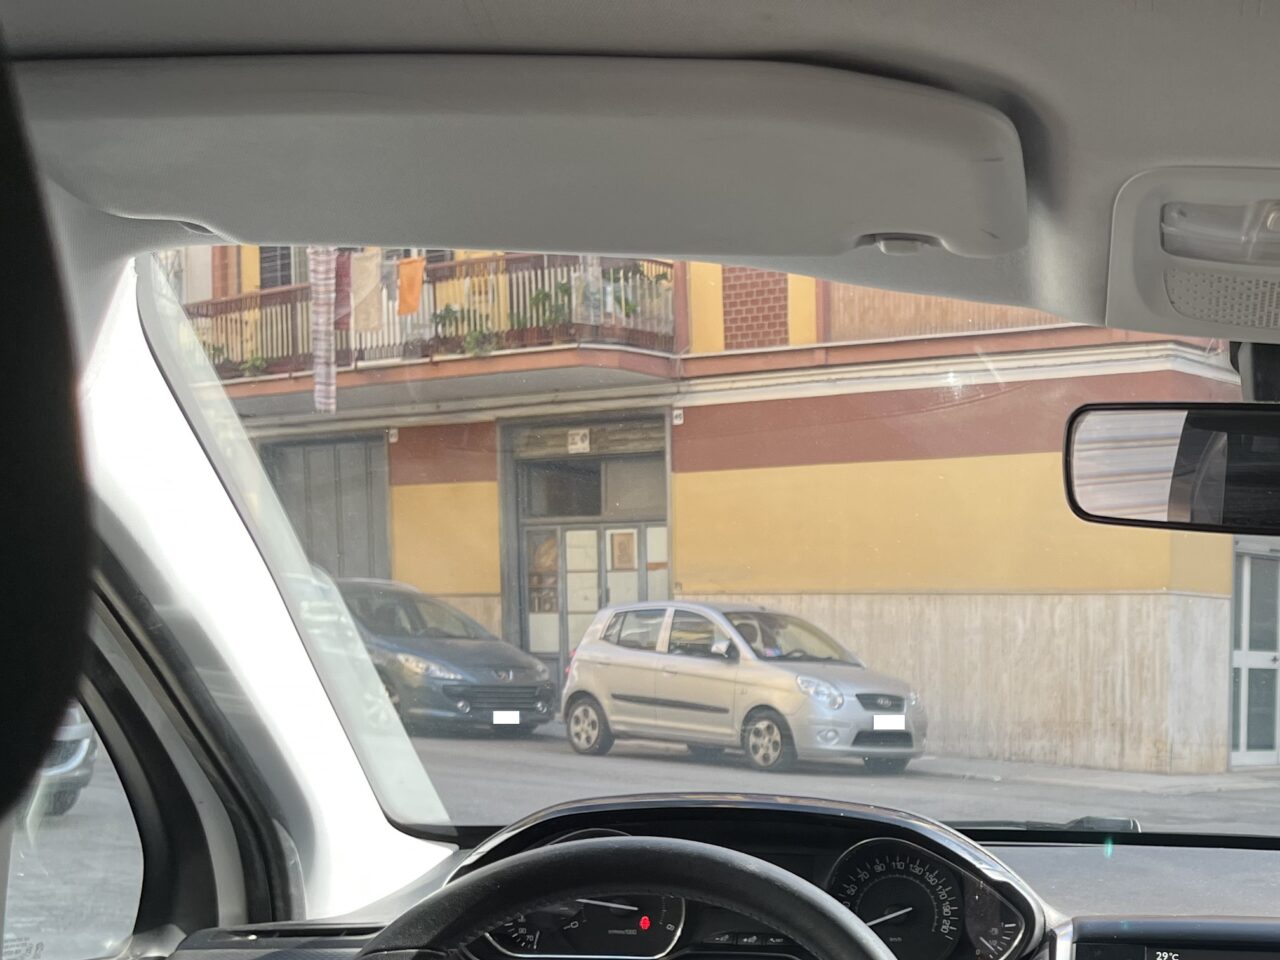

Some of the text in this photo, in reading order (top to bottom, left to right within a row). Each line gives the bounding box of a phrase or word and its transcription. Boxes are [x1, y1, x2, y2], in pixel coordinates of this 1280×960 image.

[874, 863, 886, 872] 90
[892, 861, 905, 870] 110
[909, 864, 923, 875] 130
[857, 871, 870, 881] 70
[925, 872, 938, 886] 150
[936, 885, 947, 900] 170
[942, 901, 951, 916] 190
[941, 919, 951, 934] 210
